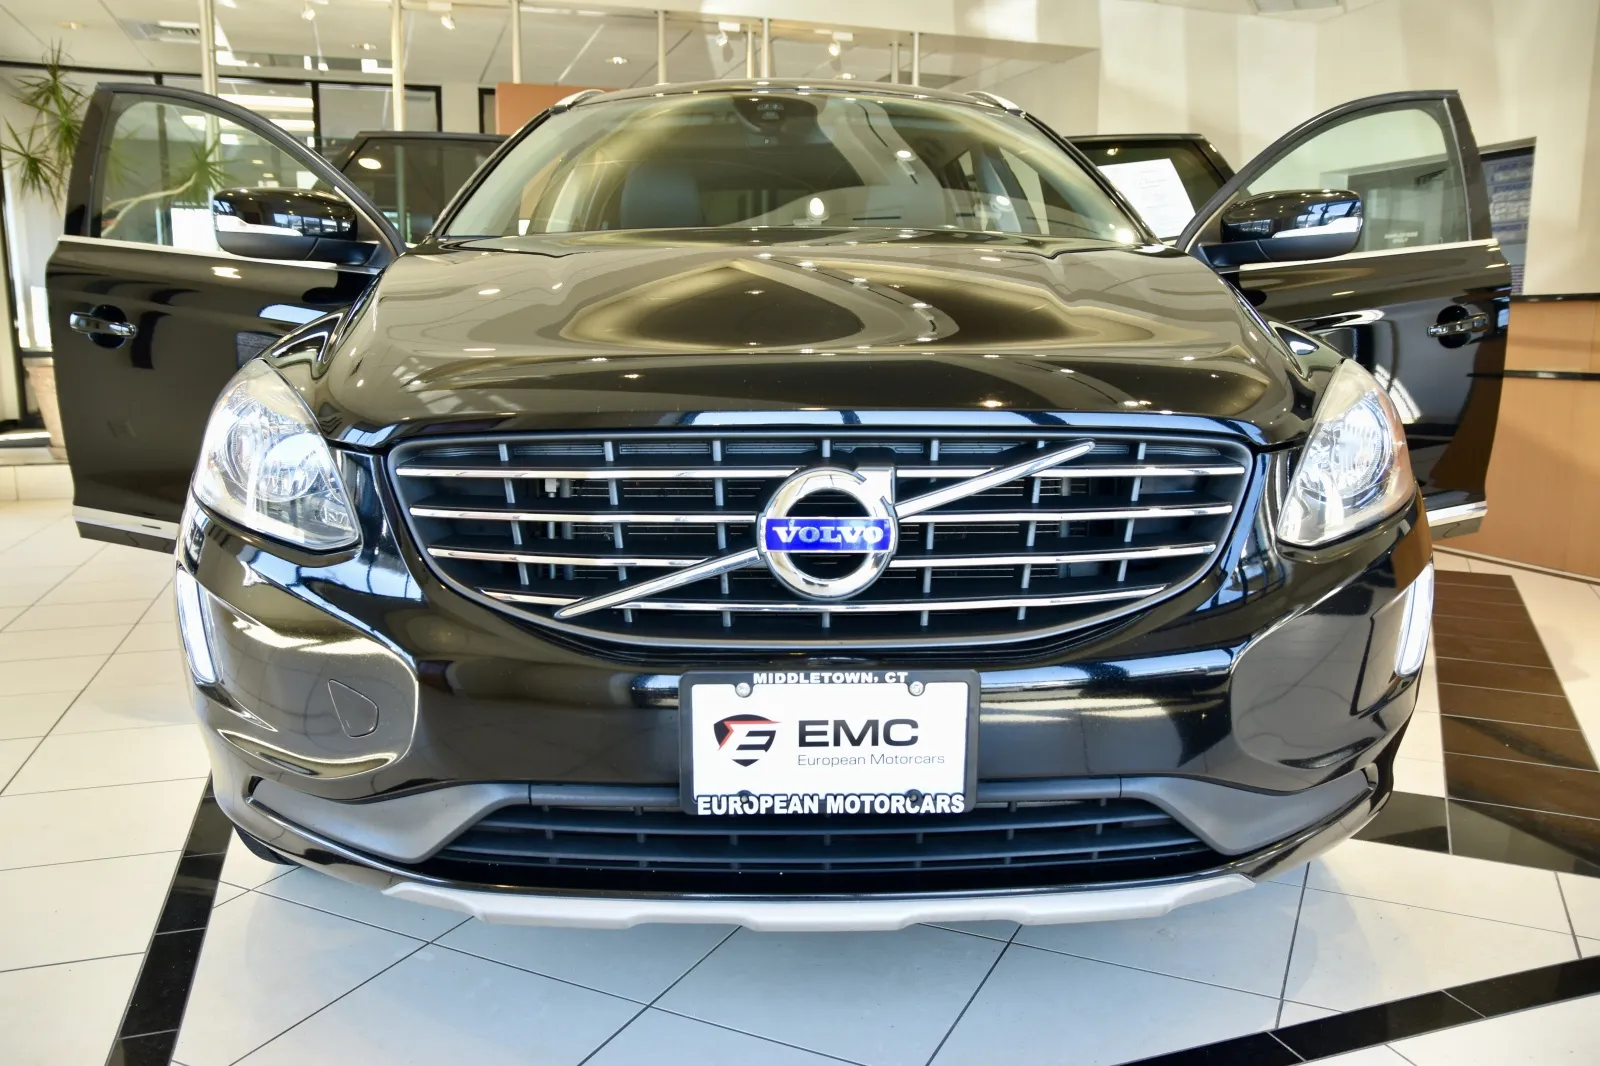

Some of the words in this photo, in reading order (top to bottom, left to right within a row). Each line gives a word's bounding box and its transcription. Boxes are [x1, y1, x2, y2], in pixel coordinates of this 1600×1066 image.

[772, 526, 885, 544] VOLVO
[753, 672, 880, 684] MIDDLETOWN,
[885, 672, 909, 684] CT
[798, 719, 919, 747] EMC
[797, 754, 866, 768] European
[870, 754, 946, 765] Motorcars
[697, 795, 819, 816] EUROPEAN
[826, 794, 965, 816] MOTORCARS
